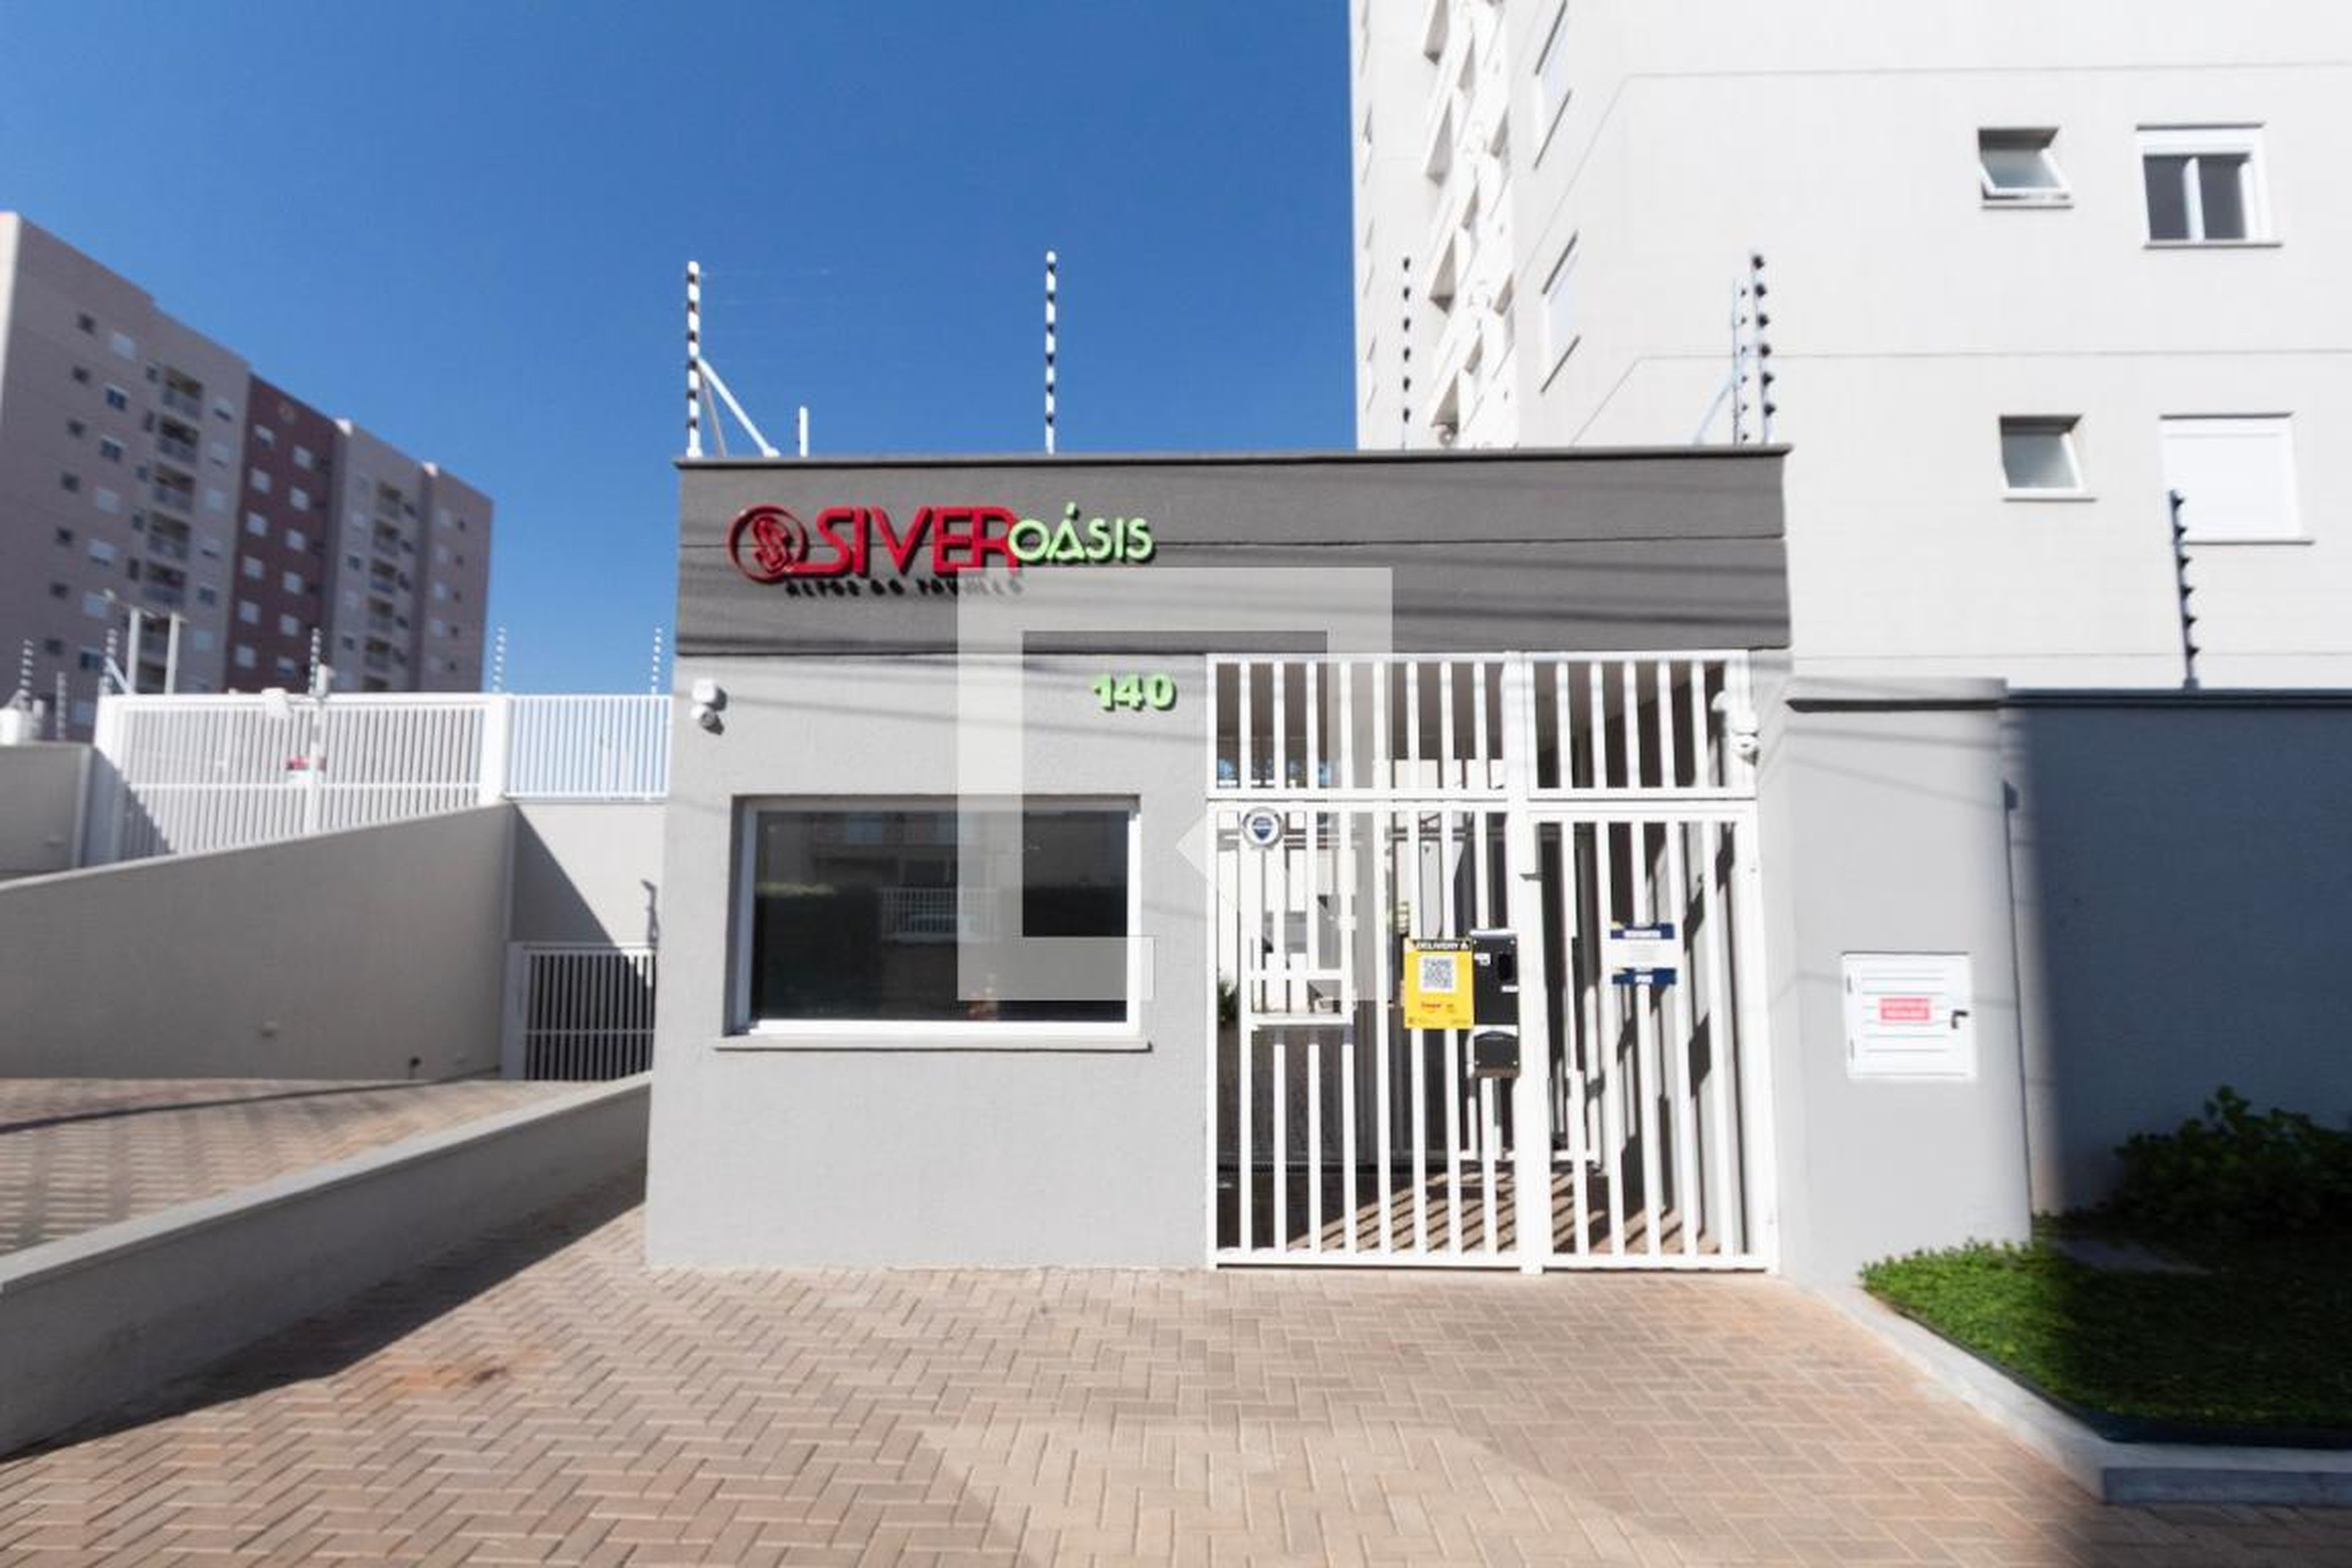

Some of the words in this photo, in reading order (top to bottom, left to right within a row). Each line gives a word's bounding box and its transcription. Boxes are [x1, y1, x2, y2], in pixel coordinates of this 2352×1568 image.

[789, 506, 1019, 577] SIVER
[1008, 502, 1154, 561] OÁSIS
[1093, 673, 1176, 710] 140
